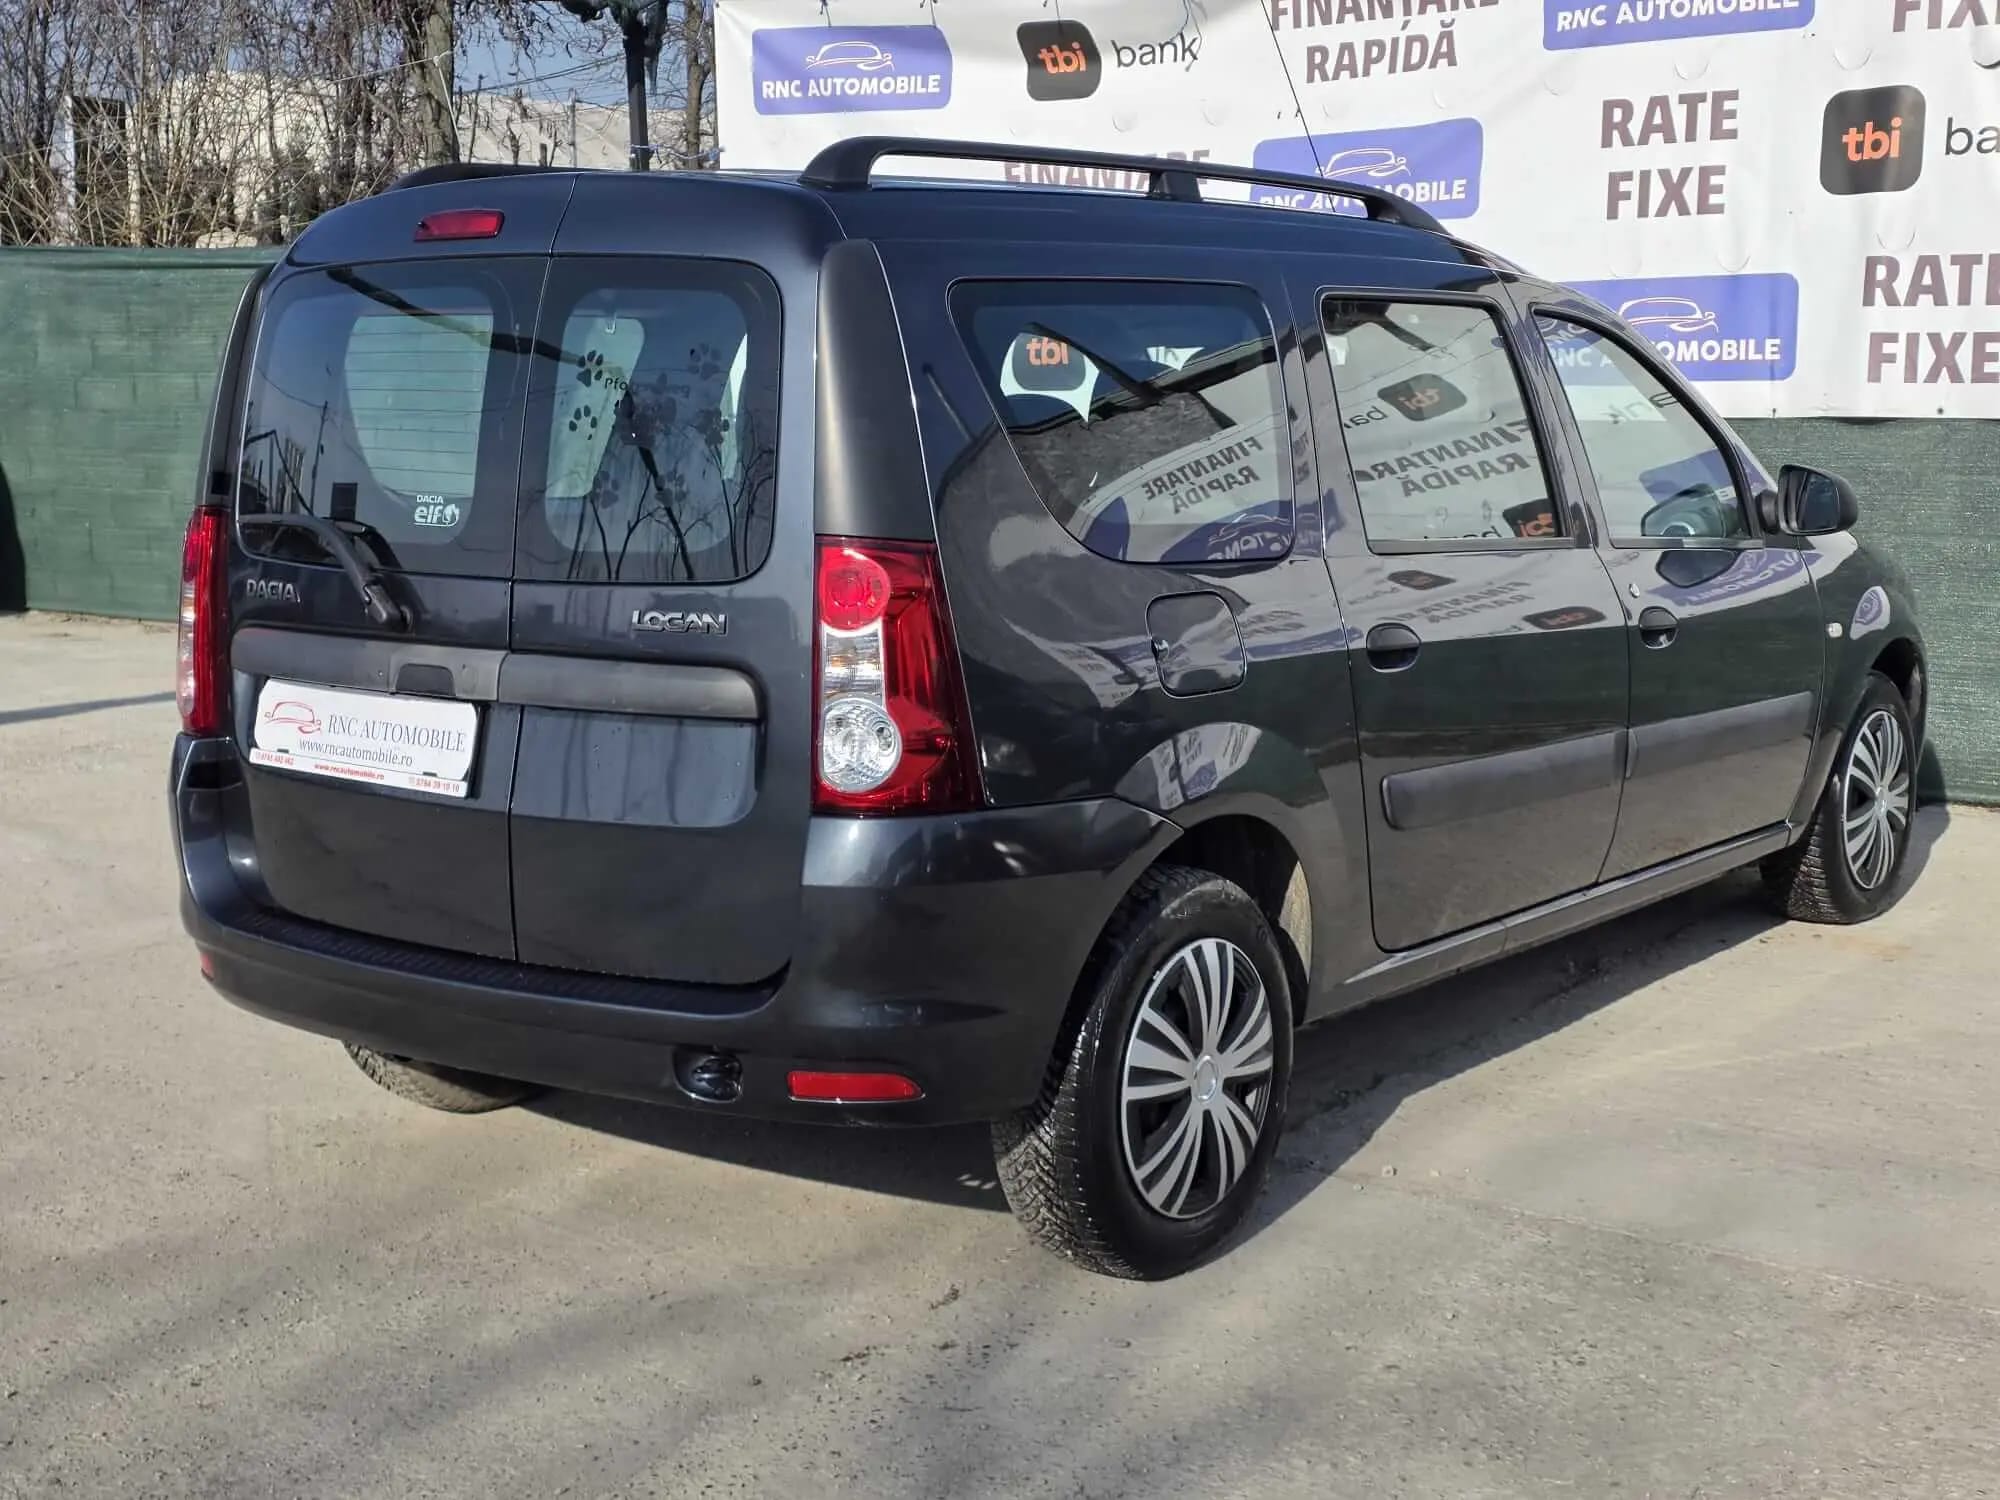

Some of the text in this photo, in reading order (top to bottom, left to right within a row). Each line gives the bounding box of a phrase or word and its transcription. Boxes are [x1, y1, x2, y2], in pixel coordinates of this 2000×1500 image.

[1557, 5, 1607, 32] RNC
[1038, 34, 1199, 75] tbi bank
[762, 75, 941, 99] RNC AUTOMOBILE
[1600, 89, 1739, 149] RATE
[1841, 117, 2000, 162] tbi ba
[1606, 165, 1726, 220] FIXE
[1867, 331, 2000, 383] FIXE
[414, 504, 444, 523] elf
[416, 494, 444, 504] DACIA
[246, 578, 298, 602] DACIA
[631, 609, 729, 637] LOGAN
[328, 713, 466, 753] RNC AUTOMOBILE
[299, 738, 413, 767] www.rncautomobile.ro
